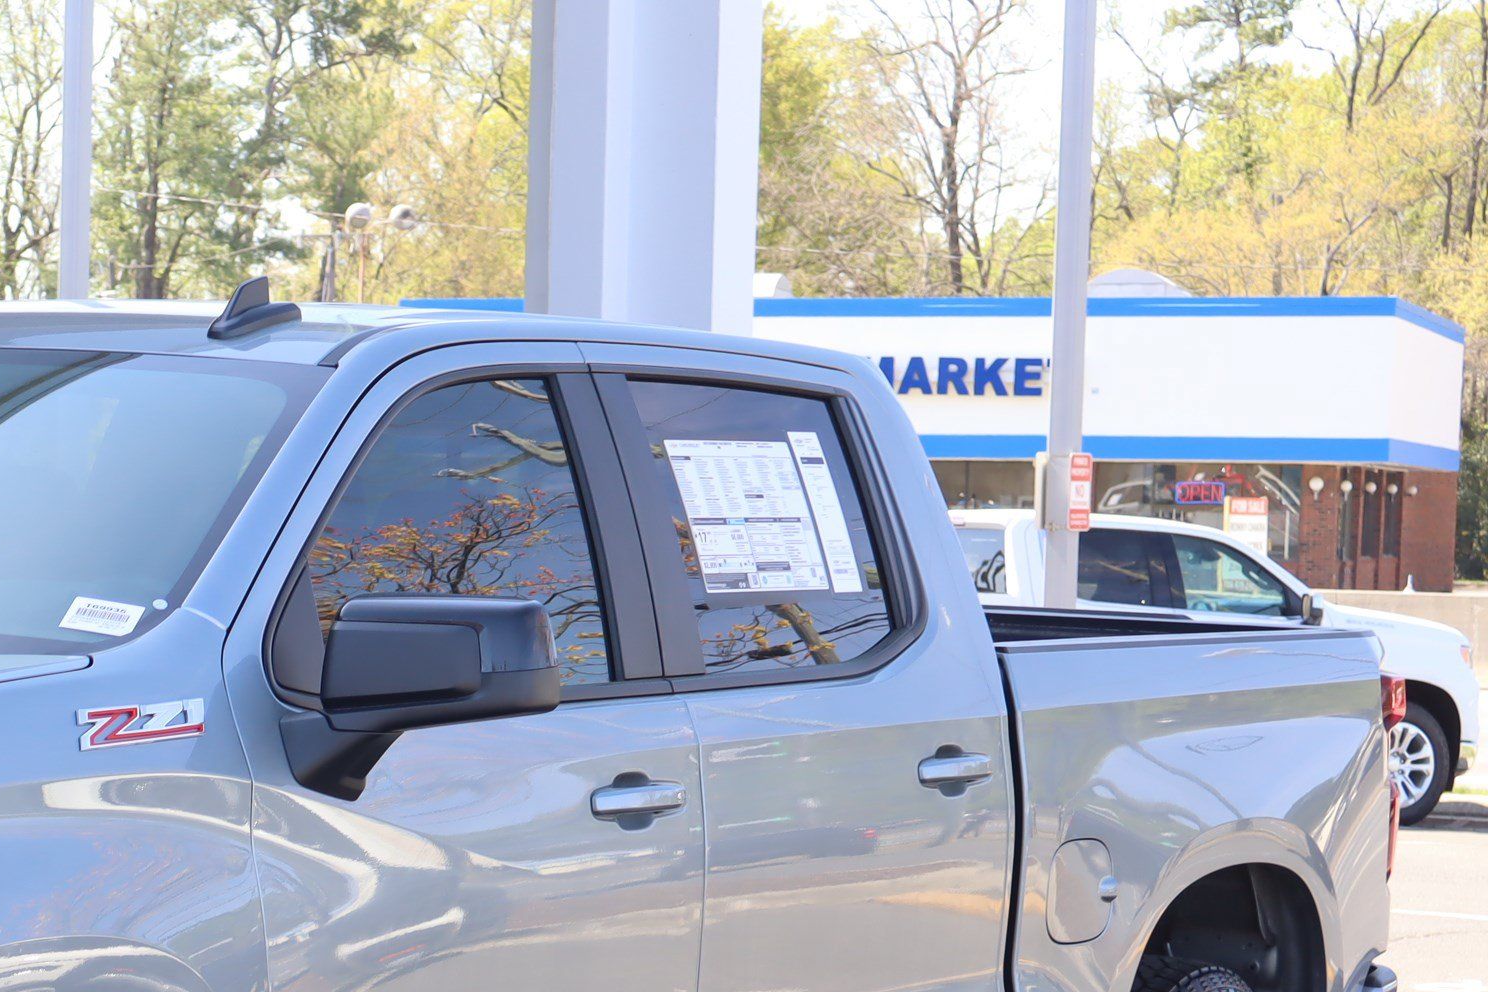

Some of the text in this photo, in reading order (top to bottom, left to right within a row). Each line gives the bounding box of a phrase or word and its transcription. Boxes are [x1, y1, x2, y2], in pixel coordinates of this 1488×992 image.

[879, 356, 1051, 397] ARKE
[1179, 484, 1222, 503] OPEN
[76, 698, 205, 751] Z71
